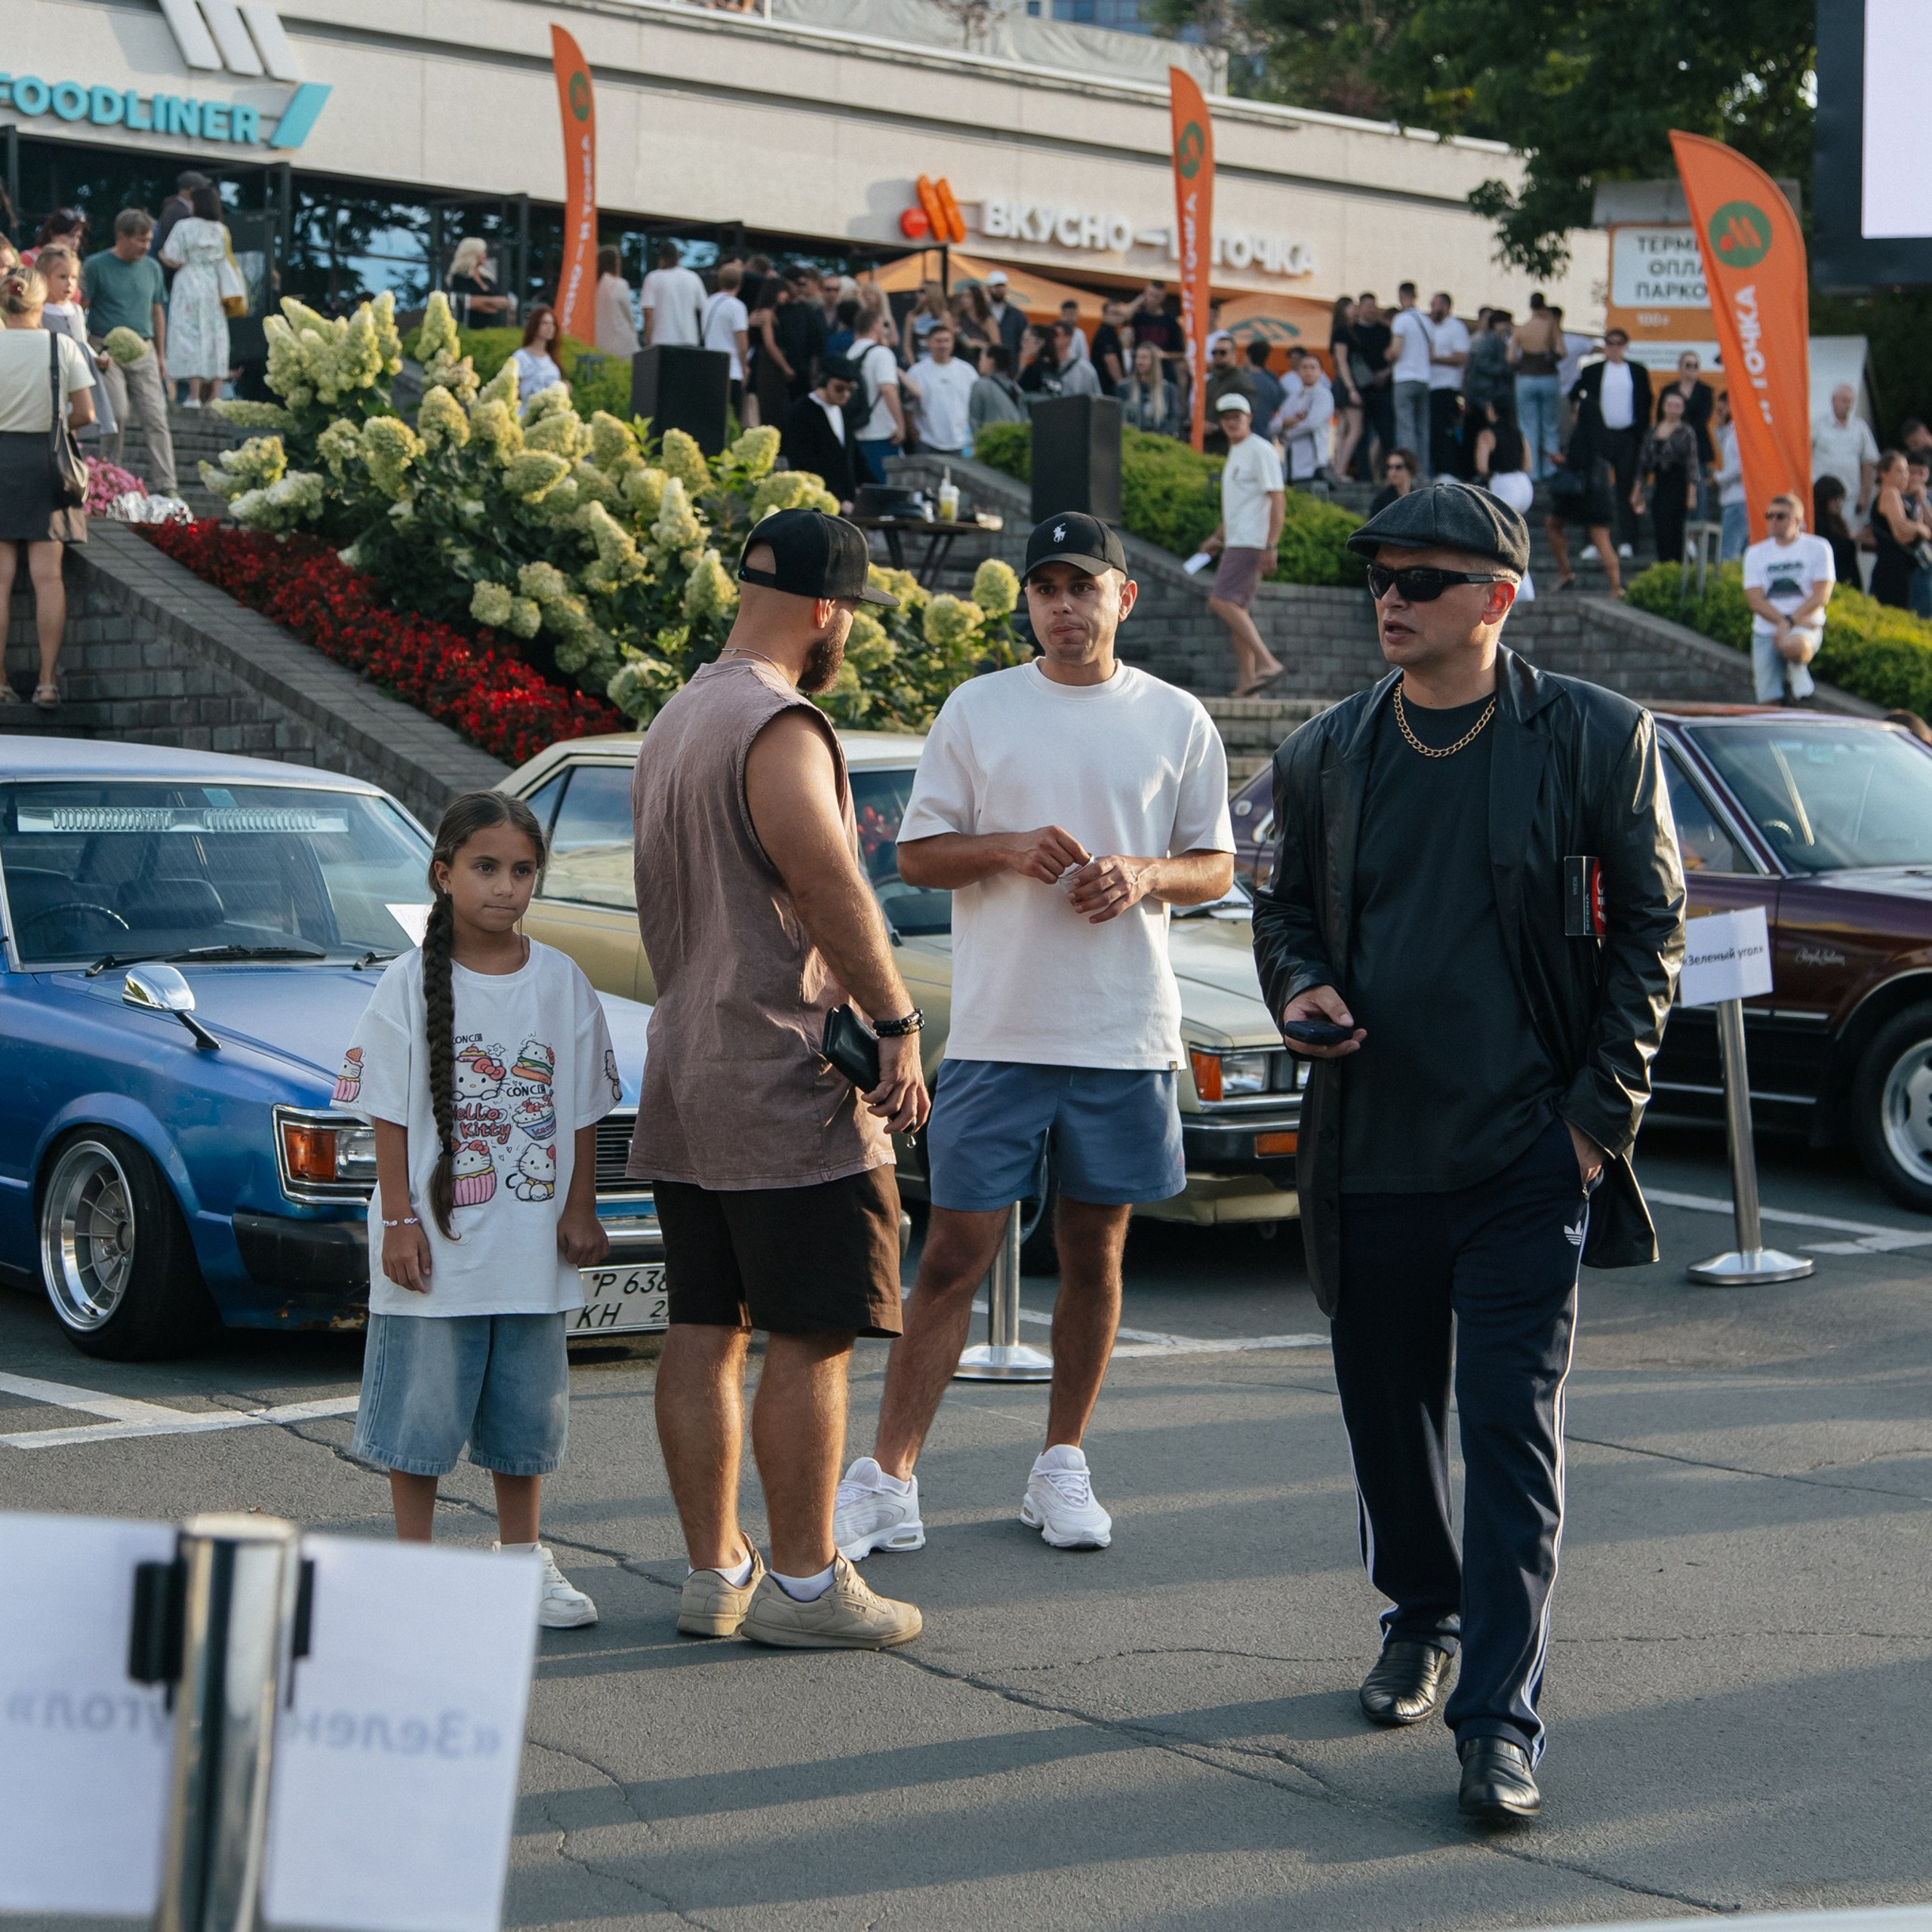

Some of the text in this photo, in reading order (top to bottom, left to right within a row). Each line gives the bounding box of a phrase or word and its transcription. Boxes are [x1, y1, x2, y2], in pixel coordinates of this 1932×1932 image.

[983, 200, 1132, 252] ВКУСНО
[1638, 235, 1700, 252] ТЕРМ
[1637, 282, 1707, 299] ПАРКО
[460, 1121, 512, 1145] Kitty
[650, 1300, 669, 1318] 2
